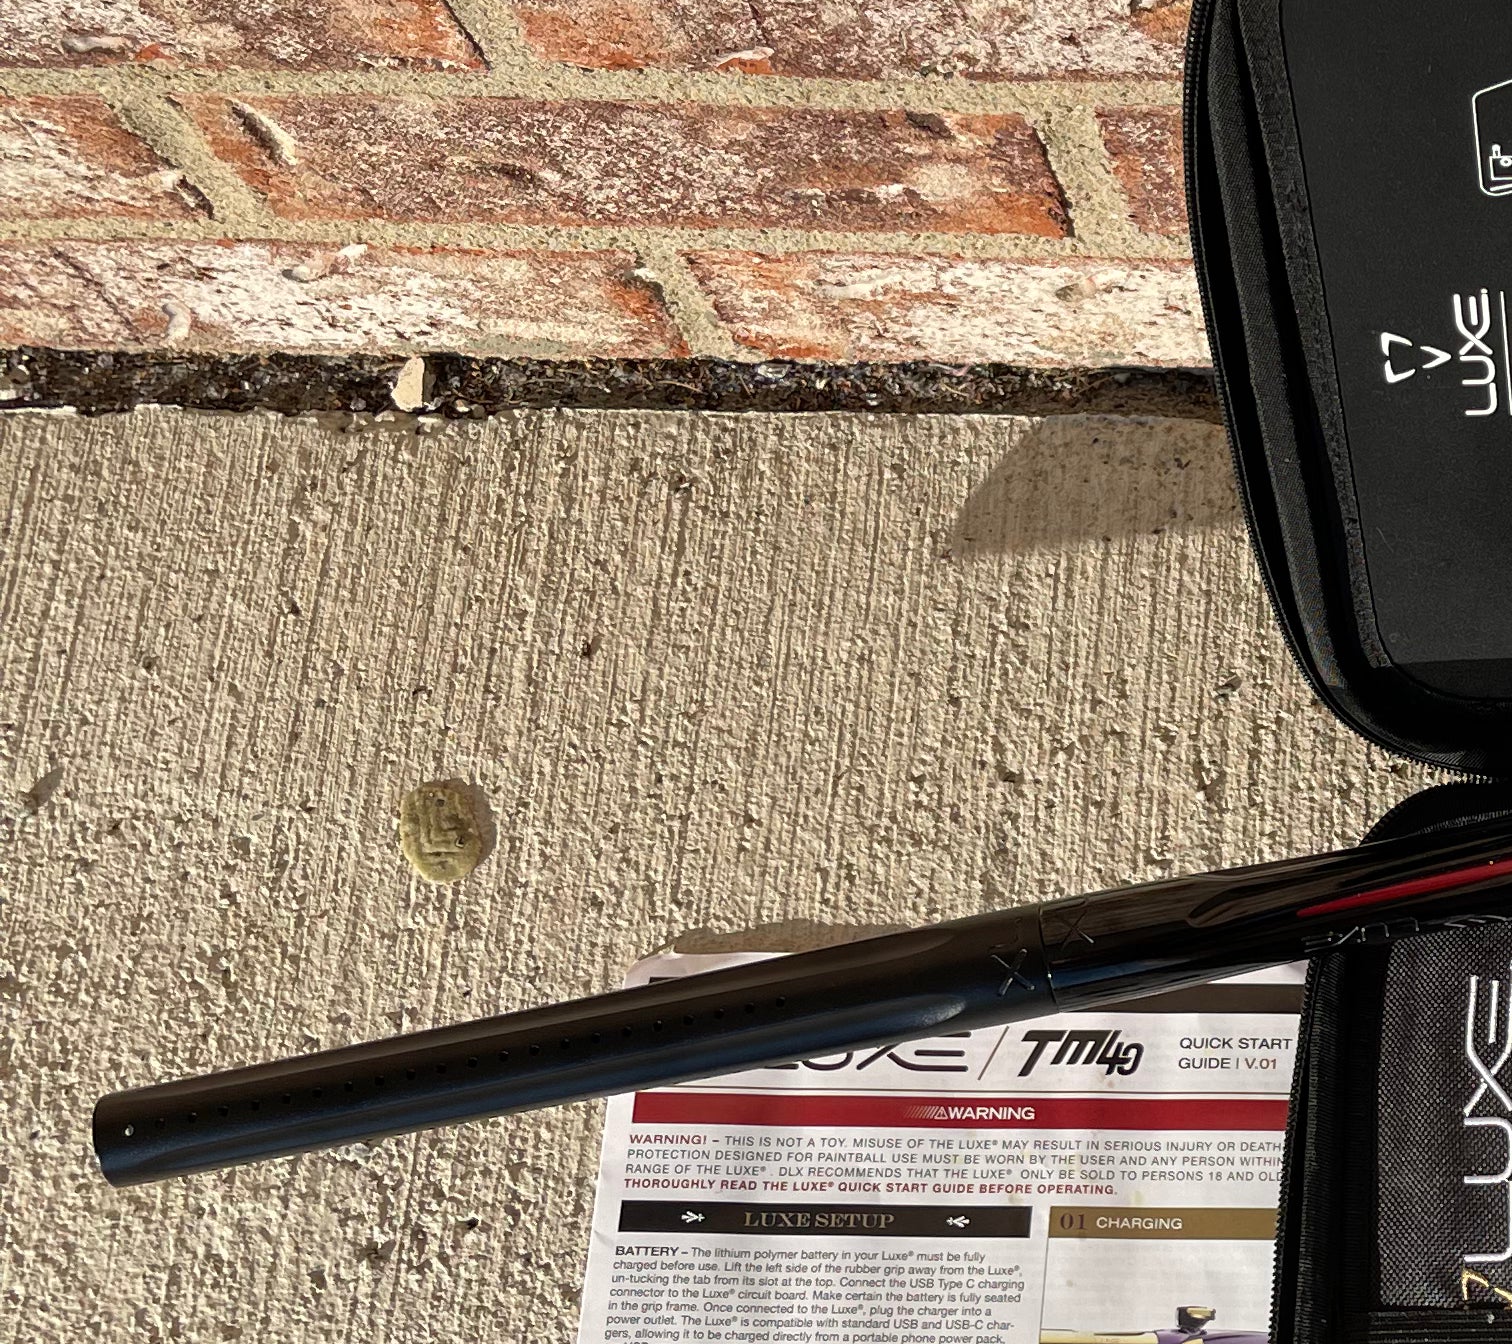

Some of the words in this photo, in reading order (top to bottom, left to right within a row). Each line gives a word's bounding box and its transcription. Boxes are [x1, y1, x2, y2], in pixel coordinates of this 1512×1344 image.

[1179, 1037, 1233, 1050] QUICK
[1238, 1037, 1293, 1050] START
[1178, 1057, 1231, 1070] GUIDE
[1244, 1057, 1277, 1070] V.01
[946, 1106, 1035, 1120] WARNING
[629, 1134, 707, 1145] WARNING!
[724, 1135, 755, 1147] THIS
[759, 1136, 772, 1148] IS
[776, 1137, 803, 1148] NOT
[806, 1137, 815, 1148] A
[853, 1137, 902, 1149] MISUSE
[906, 1138, 925, 1149] OF
[929, 1138, 954, 1150] THE
[1002, 1139, 1029, 1150] MAY
[1033, 1139, 1082, 1151] RESULT
[1086, 1140, 1100, 1151] IN
[1104, 1140, 1162, 1152] SERIOUS
[1166, 1141, 1213, 1152] INJURY
[1217, 1141, 1236, 1152] OR
[624, 1178, 716, 1190] THOROUGHLY
[720, 1179, 757, 1191] READ
[762, 1180, 788, 1191] THE
[838, 1181, 881, 1193] QUICK
[886, 1182, 928, 1193] START
[932, 1183, 975, 1194] GUIDE
[979, 1183, 1032, 1194] BEFORE
[1037, 1184, 1117, 1195] OPERATING.
[744, 1211, 811, 1228] LUXE
[814, 1213, 894, 1228] SETUP
[1060, 1212, 1087, 1230] 01
[1096, 1216, 1183, 1230] CHARGING
[615, 1245, 679, 1257] BATTERY
[691, 1246, 712, 1258] The
[714, 1247, 751, 1259] lithium
[753, 1249, 799, 1262] polymer
[800, 1249, 839, 1262] battery
[841, 1251, 851, 1260] in
[854, 1251, 879, 1263] your
[916, 1252, 944, 1262] must
[946, 1251, 961, 1262] be
[963, 1251, 986, 1264] fully
